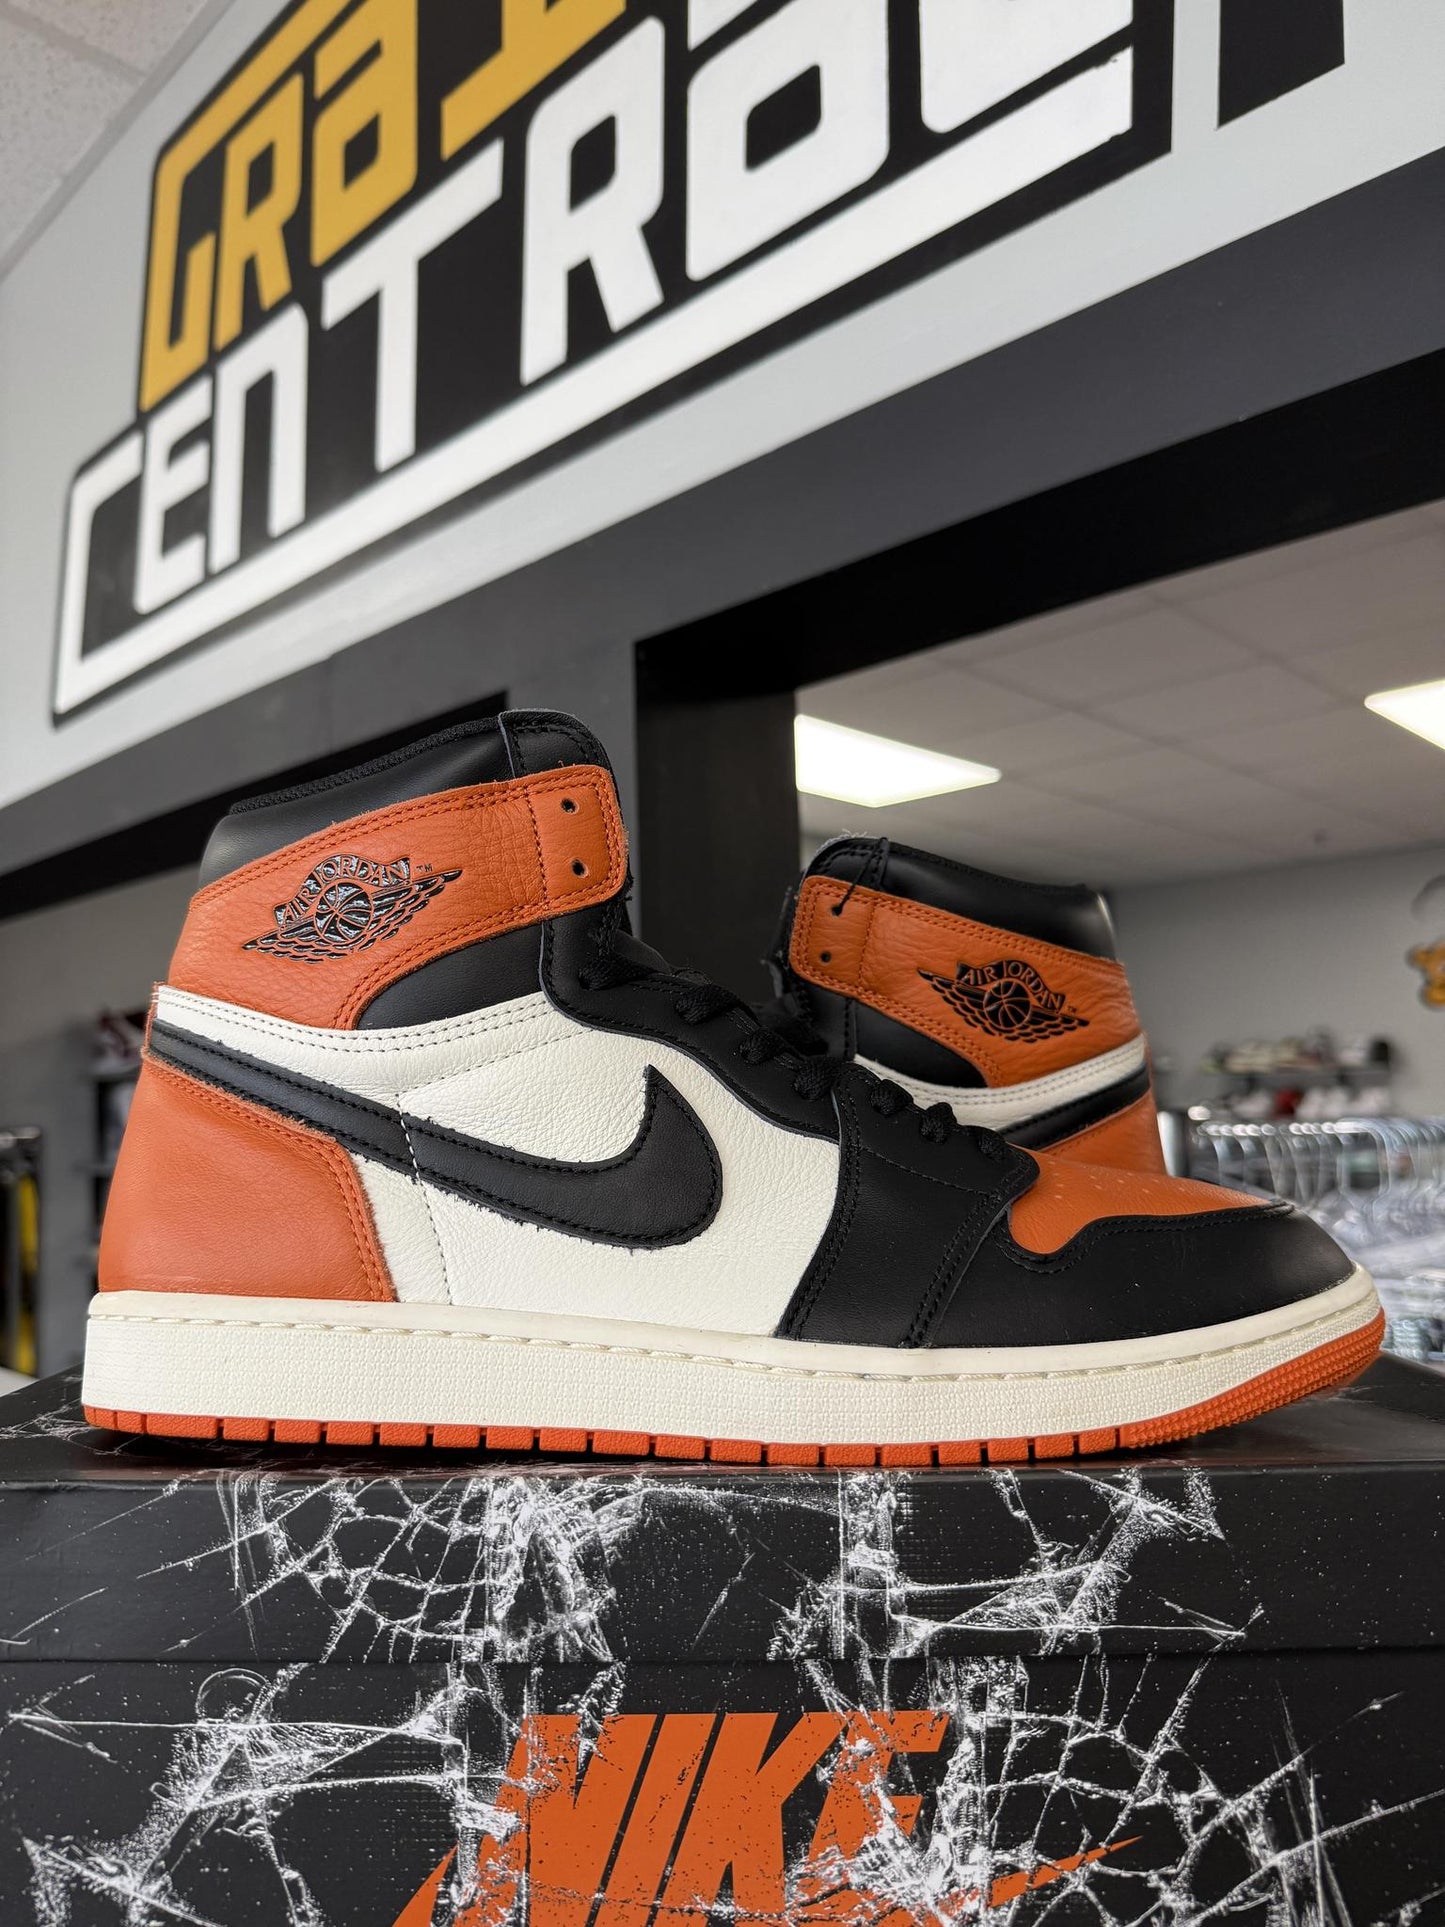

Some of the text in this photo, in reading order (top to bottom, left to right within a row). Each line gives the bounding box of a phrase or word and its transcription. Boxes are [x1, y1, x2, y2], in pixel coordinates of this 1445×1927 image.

[282, 888, 318, 926] AIR
[312, 857, 411, 889] JORDAN
[963, 966, 997, 985] AIR
[1002, 960, 1063, 1010] JORDAN
[455, 1710, 951, 1927] NIKE
